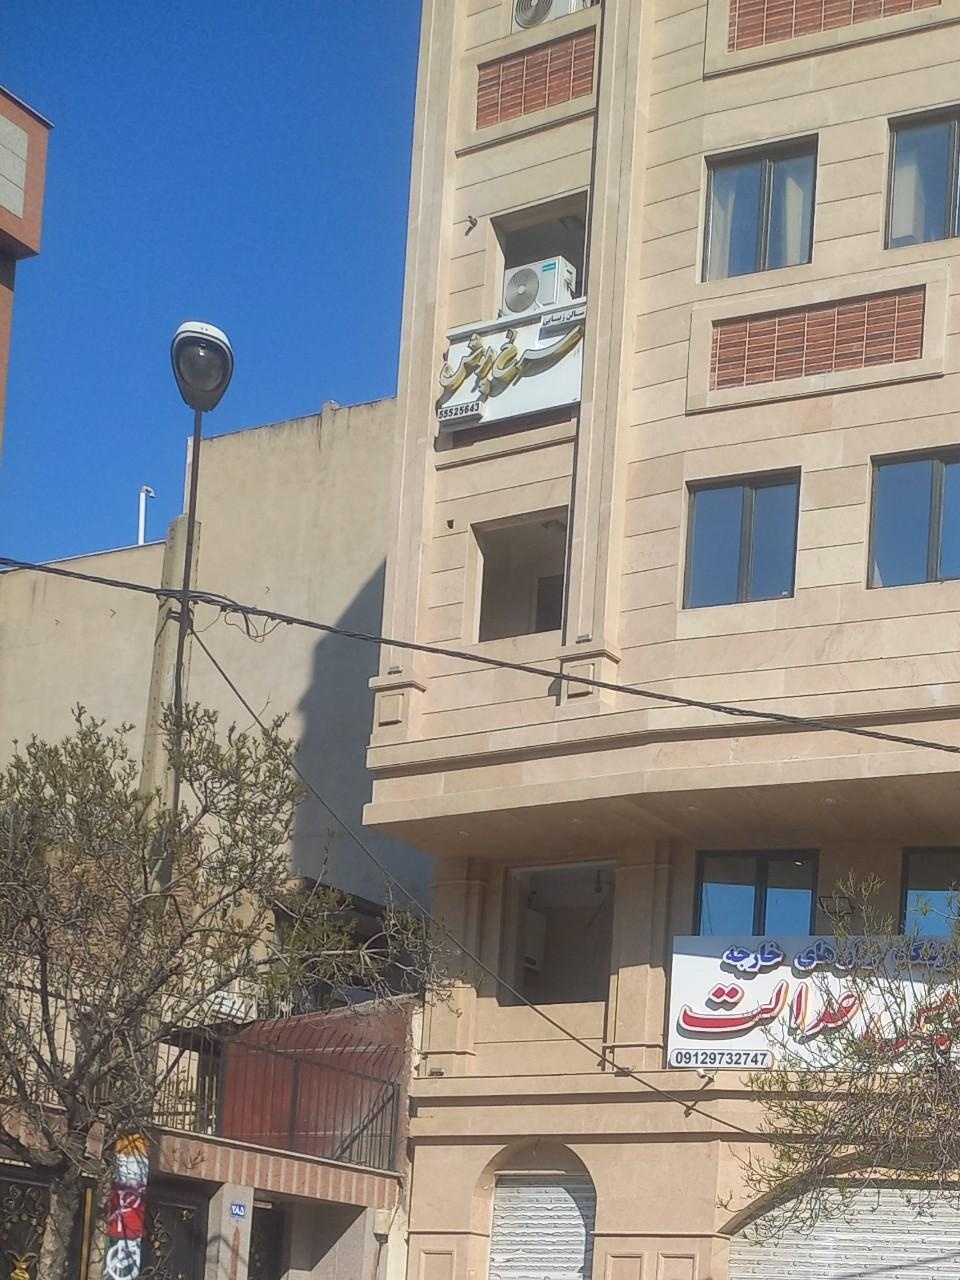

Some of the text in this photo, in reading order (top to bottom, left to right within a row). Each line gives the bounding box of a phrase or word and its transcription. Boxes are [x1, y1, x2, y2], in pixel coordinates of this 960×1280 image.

[566, 310, 585, 321] سالن
[438, 403, 480, 420] 55525643
[722, 938, 784, 971] خارجه
[678, 980, 858, 1037] عدالت
[675, 1051, 768, 1066] 09129732747
